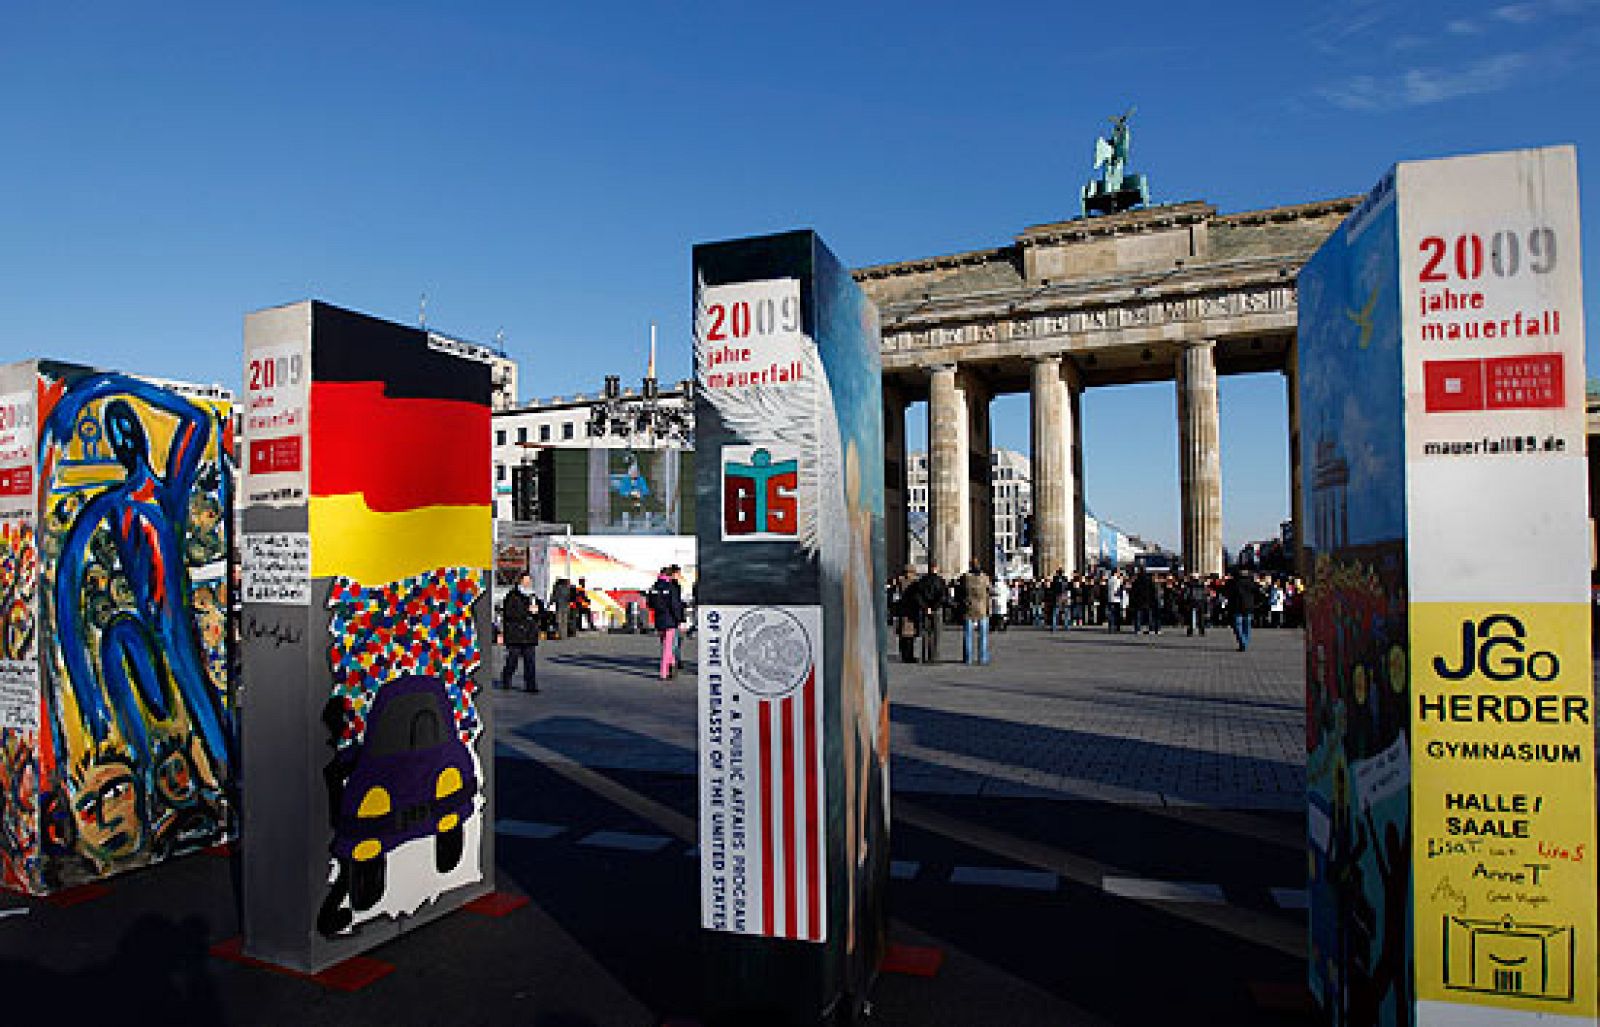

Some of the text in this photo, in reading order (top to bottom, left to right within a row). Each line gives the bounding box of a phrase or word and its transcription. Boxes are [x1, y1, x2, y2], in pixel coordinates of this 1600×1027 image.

[1419, 226, 1557, 282] 2009
[1420, 288, 1485, 317] jahre
[706, 296, 798, 341] 2009
[1421, 310, 1560, 341] mauerfall
[706, 345, 751, 370] jahre
[249, 355, 302, 391] 2009
[706, 361, 802, 388] mauerfall
[1419, 694, 1589, 725] HERDER
[1427, 741, 1582, 763] GYMNASIUM
[1445, 793, 1528, 812] HALLE
[1446, 816, 1530, 838] SAALE
